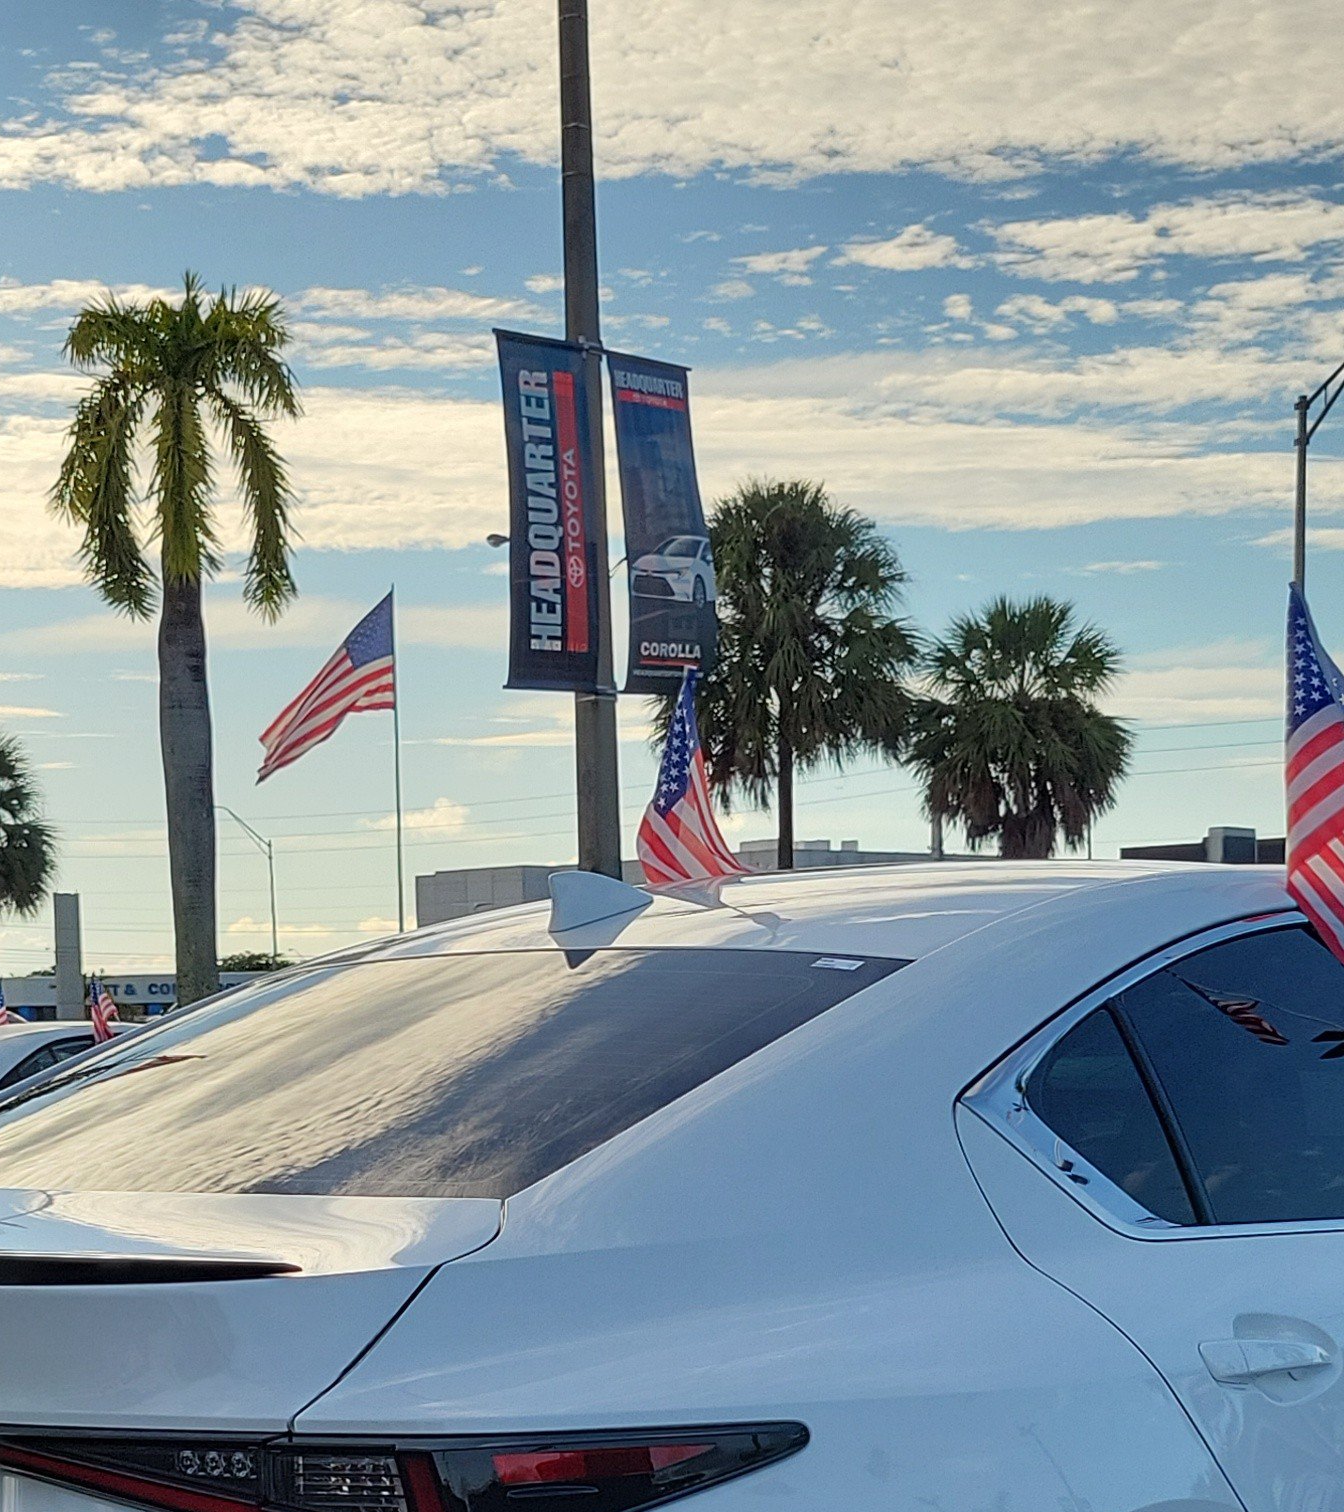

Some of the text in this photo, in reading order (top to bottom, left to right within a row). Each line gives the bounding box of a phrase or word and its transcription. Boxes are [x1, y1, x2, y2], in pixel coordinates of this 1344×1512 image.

[518, 369, 563, 652] HEADQUARTER
[563, 448, 582, 552] TOYOTA
[640, 642, 701, 659] COROLLA
